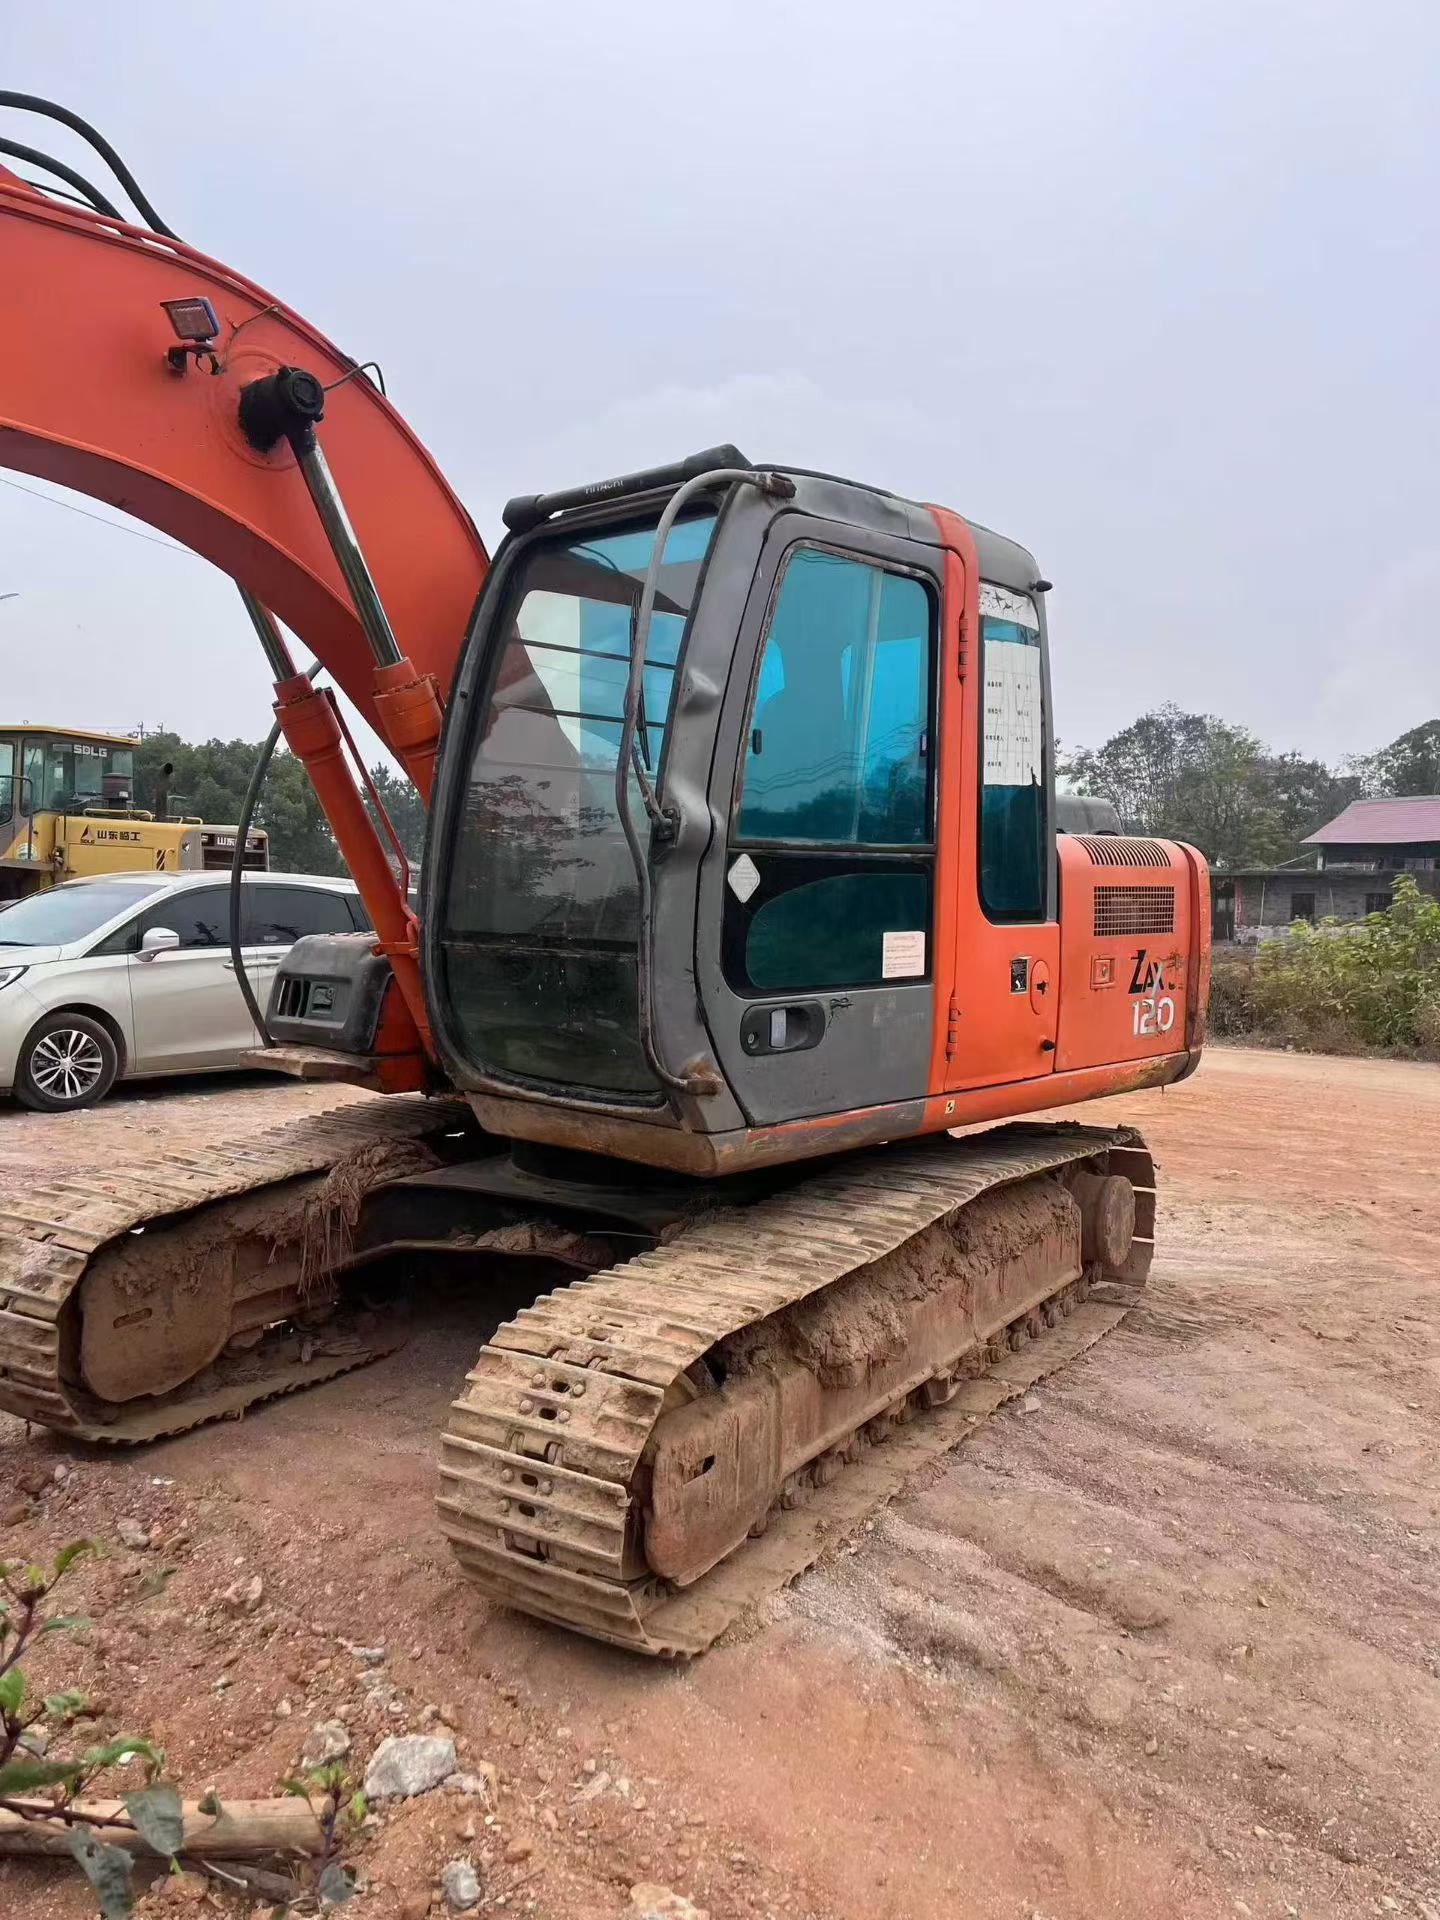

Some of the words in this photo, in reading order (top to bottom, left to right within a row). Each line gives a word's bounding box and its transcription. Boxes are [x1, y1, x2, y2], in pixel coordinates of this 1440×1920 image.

[73, 744, 107, 757] SDLG
[97, 830, 141, 842] 山东临工
[1132, 997, 1174, 1035] 120
